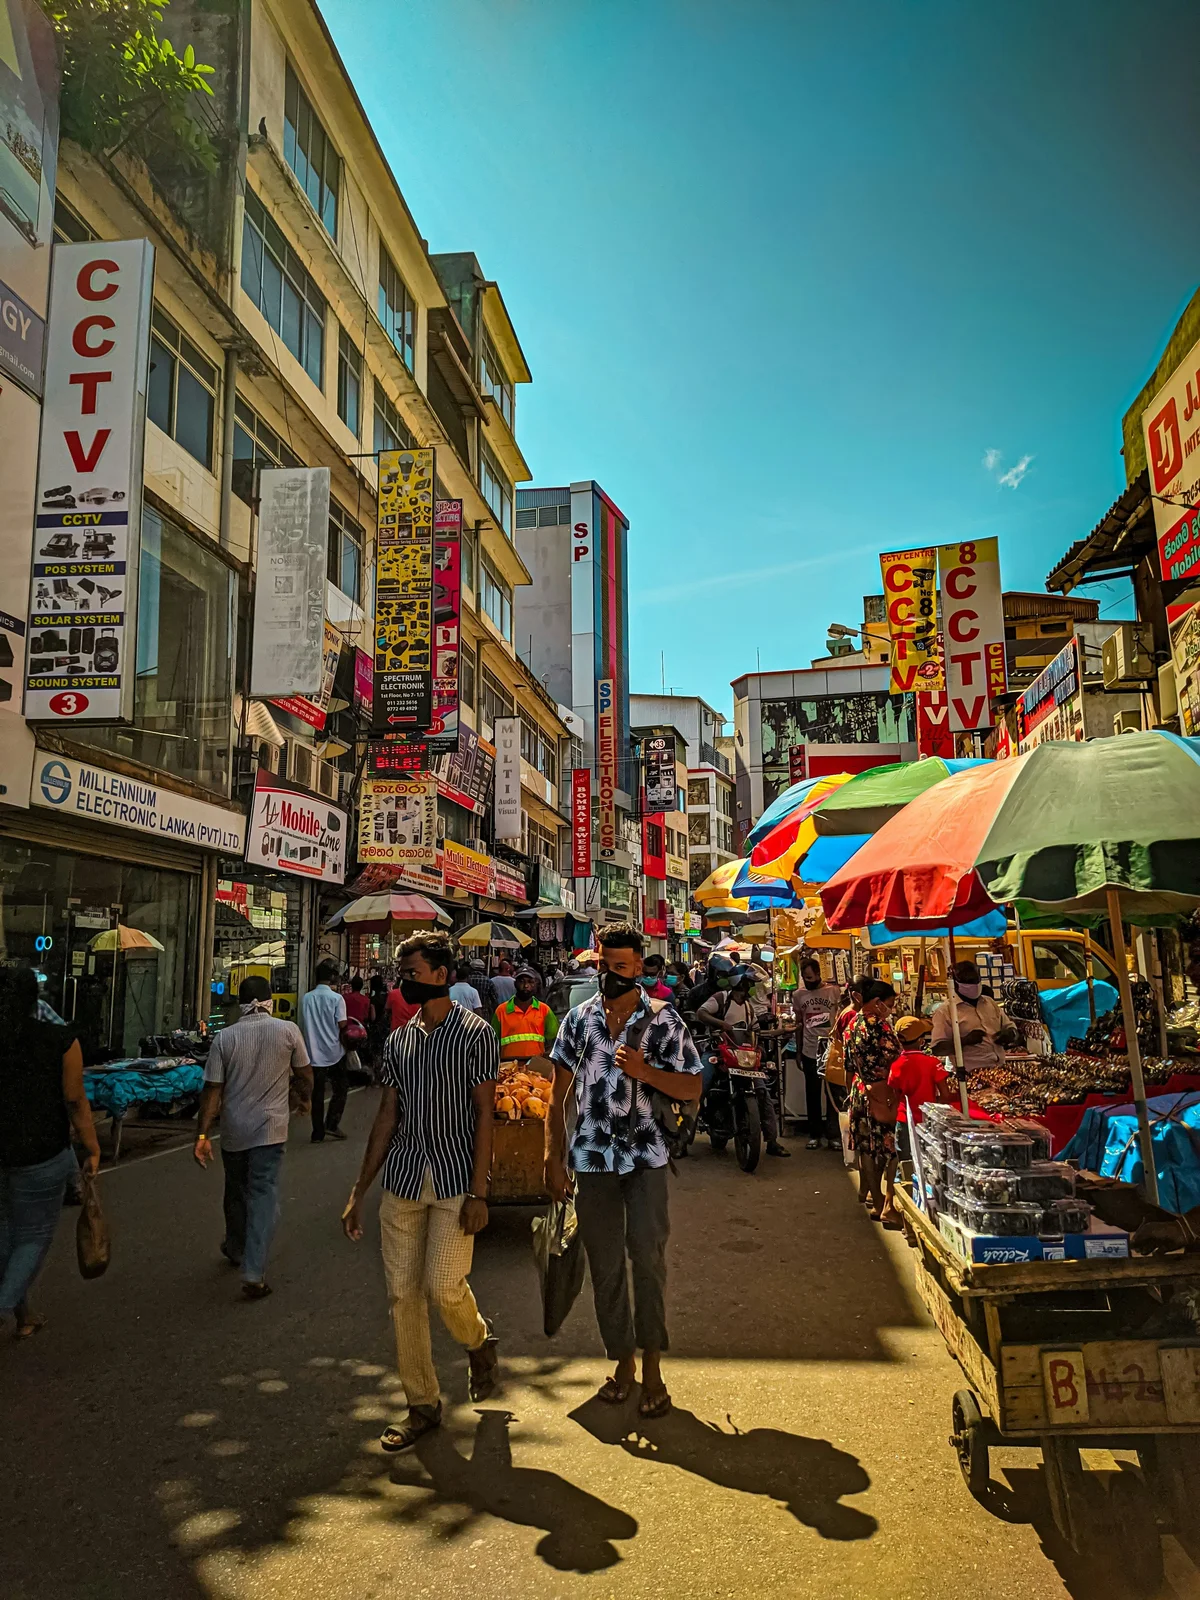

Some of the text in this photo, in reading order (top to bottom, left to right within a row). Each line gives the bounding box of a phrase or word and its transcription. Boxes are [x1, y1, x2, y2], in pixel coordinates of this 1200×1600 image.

[0, 297, 32, 341] GY
[63, 259, 120, 473] CCTV
[1184, 425, 1200, 459] INTE
[62, 513, 102, 526] CCTV
[44, 563, 115, 575] POS SYSTEM
[881, 549, 936, 564] CCTV CENTRE
[958, 541, 978, 565] 8
[33, 614, 120, 625] SOLAR SYSTEM
[919, 597, 934, 617] 8
[885, 563, 919, 691] CCTV
[945, 566, 987, 729] CCTV
[28, 677, 118, 688] SOUND SYSTEM
[380, 682, 425, 691] ELECTRONIK
[383, 674, 422, 683] SPECTRUM
[61, 694, 77, 714] 3
[501, 724, 514, 794] MULTI
[78, 768, 157, 808] MILLENNIUM
[372, 783, 427, 795] කැමරා
[599, 716, 615, 848] ELECTRONICS
[76, 791, 241, 850] ELECTRONIC LANKA (PVT) LTD.
[360, 794, 373, 846] REPAIRS
[497, 807, 518, 815] Visual
[576, 786, 588, 823] BOMBAY
[280, 800, 320, 838] Mobile
[318, 824, 341, 852] Zone
[575, 826, 589, 864] SWEETS
[445, 848, 465, 868] Multi
[465, 855, 496, 878] Electronics
[801, 997, 834, 1011] IMPOSSIBLE
[1048, 1358, 1080, 1409] B
